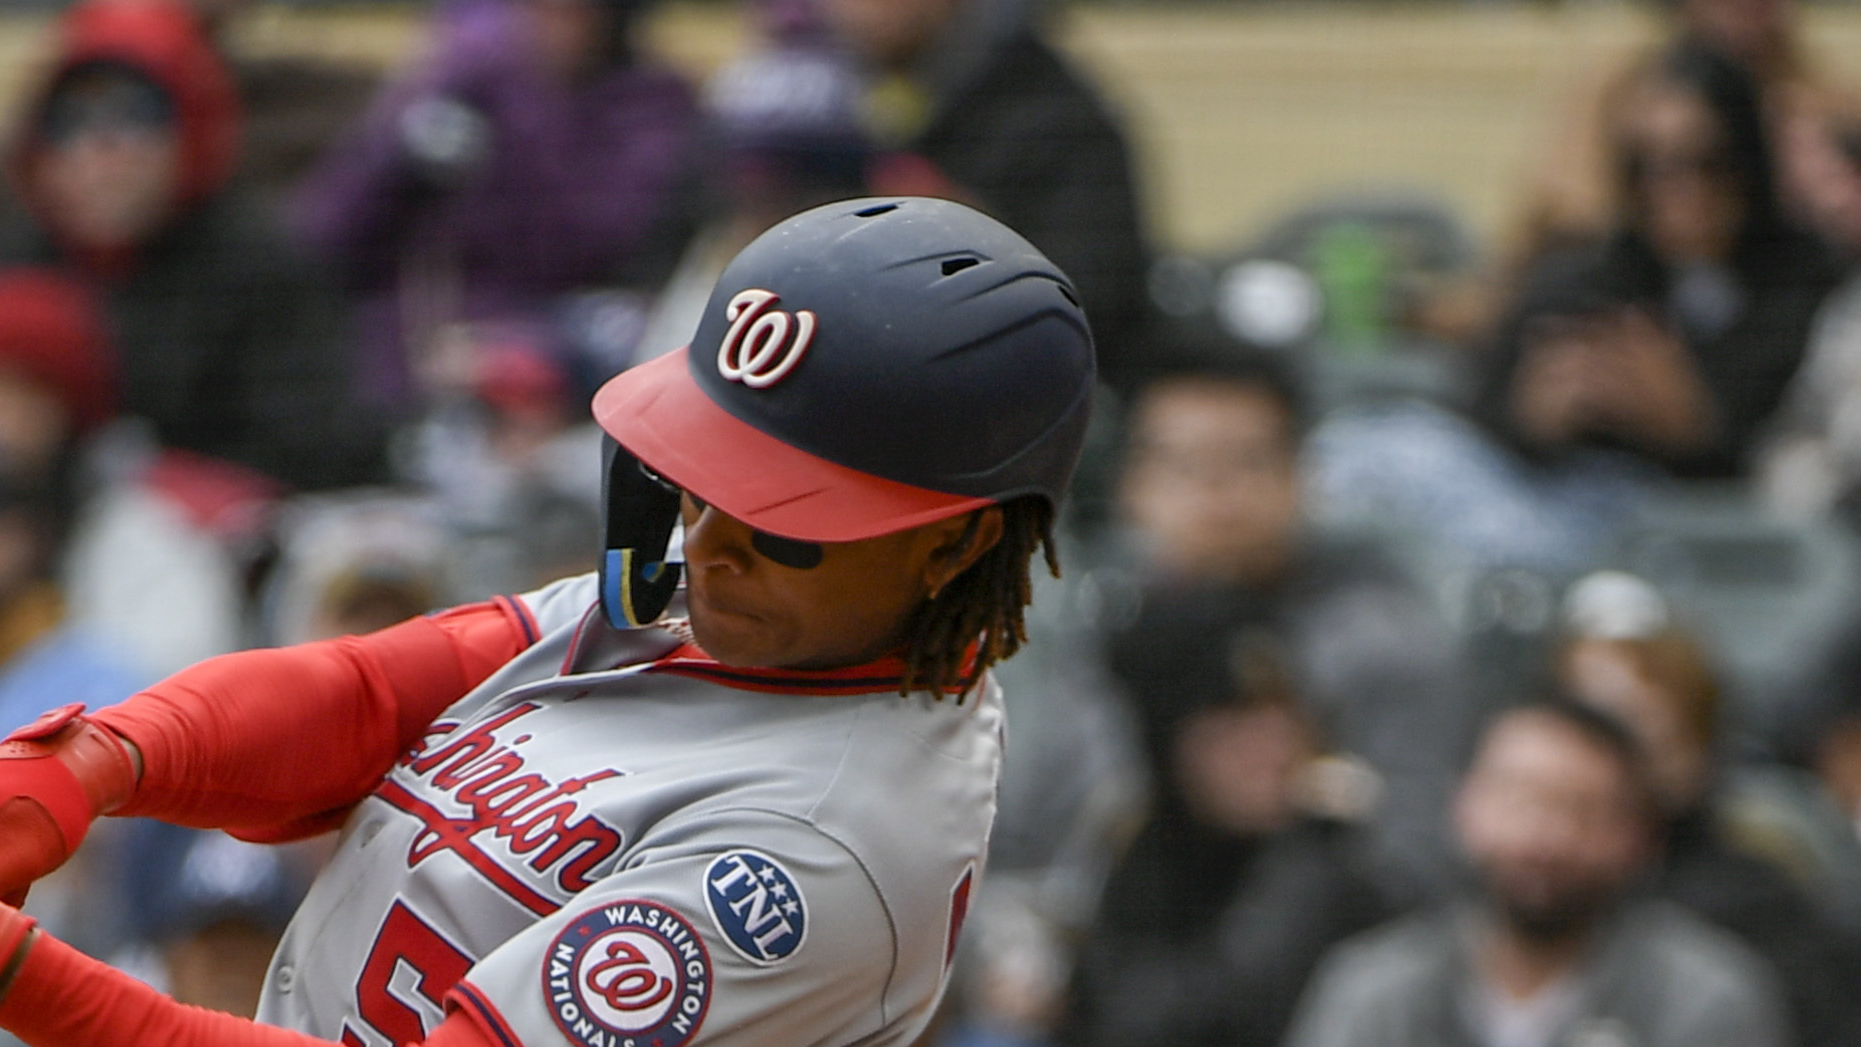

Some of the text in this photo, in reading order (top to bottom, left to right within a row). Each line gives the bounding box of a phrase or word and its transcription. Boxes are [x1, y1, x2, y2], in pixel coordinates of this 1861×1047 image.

[717, 287, 818, 390] W
[400, 702, 626, 893] hington
[710, 855, 794, 961] TNL
[585, 940, 673, 1012] W
[604, 905, 705, 1035] WASHINGTON
